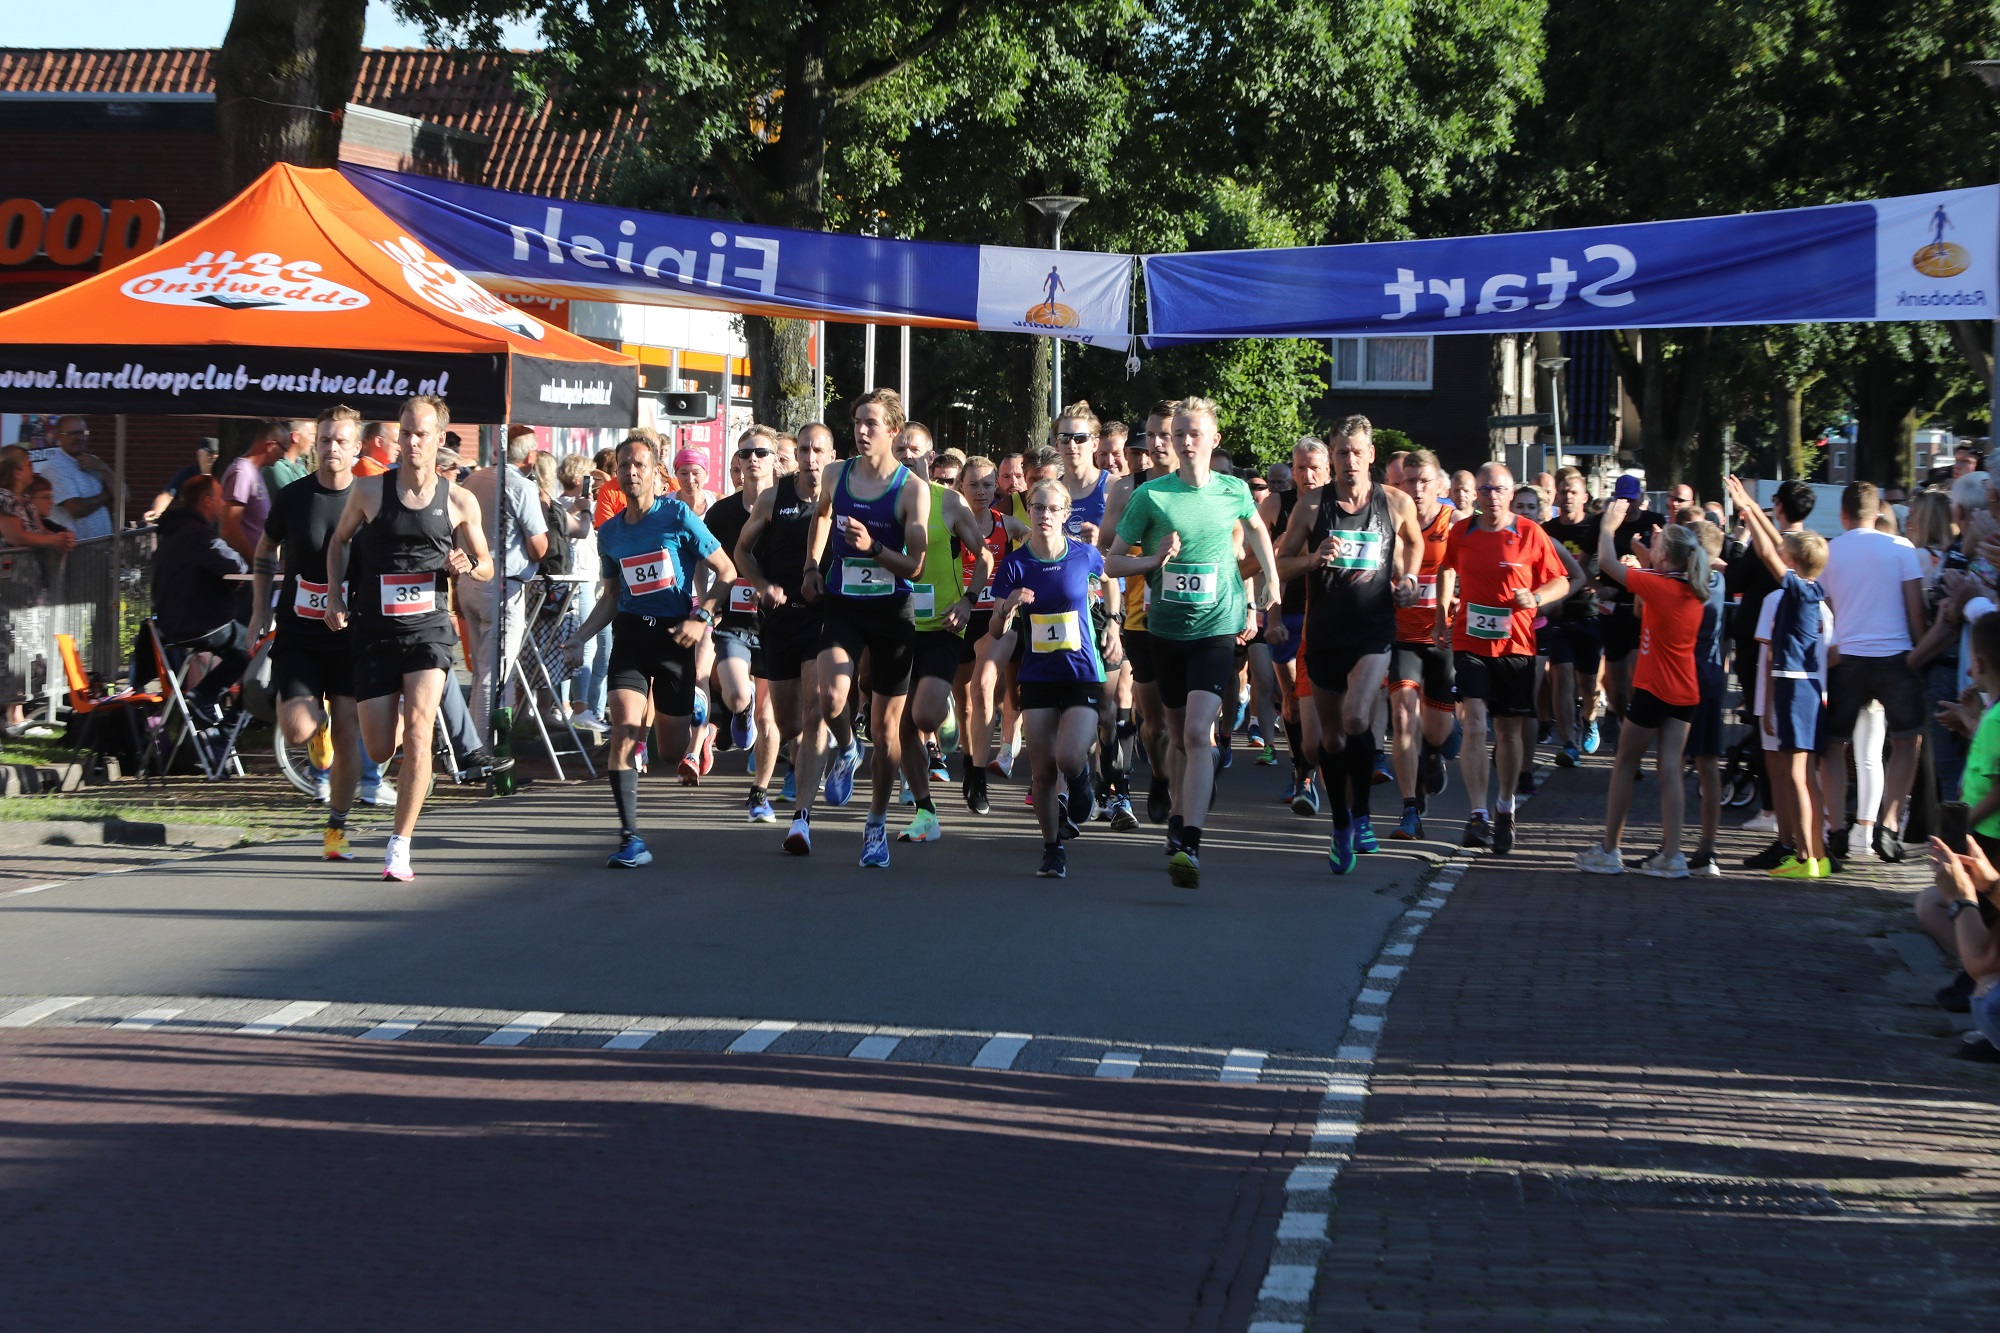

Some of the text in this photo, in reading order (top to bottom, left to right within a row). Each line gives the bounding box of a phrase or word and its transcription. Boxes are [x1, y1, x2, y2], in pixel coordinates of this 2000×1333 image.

[131, 277, 360, 306] Onstwedde
[0, 362, 450, 397] www.hardloopclub-onstwedde.nl
[1342, 542, 1364, 557] 27
[635, 564, 659, 582] 84
[861, 569, 872, 584] 2
[1175, 576, 1201, 591] 30
[395, 586, 421, 602] 38
[1476, 615, 1497, 630] 24
[1047, 625, 1060, 641] 1
